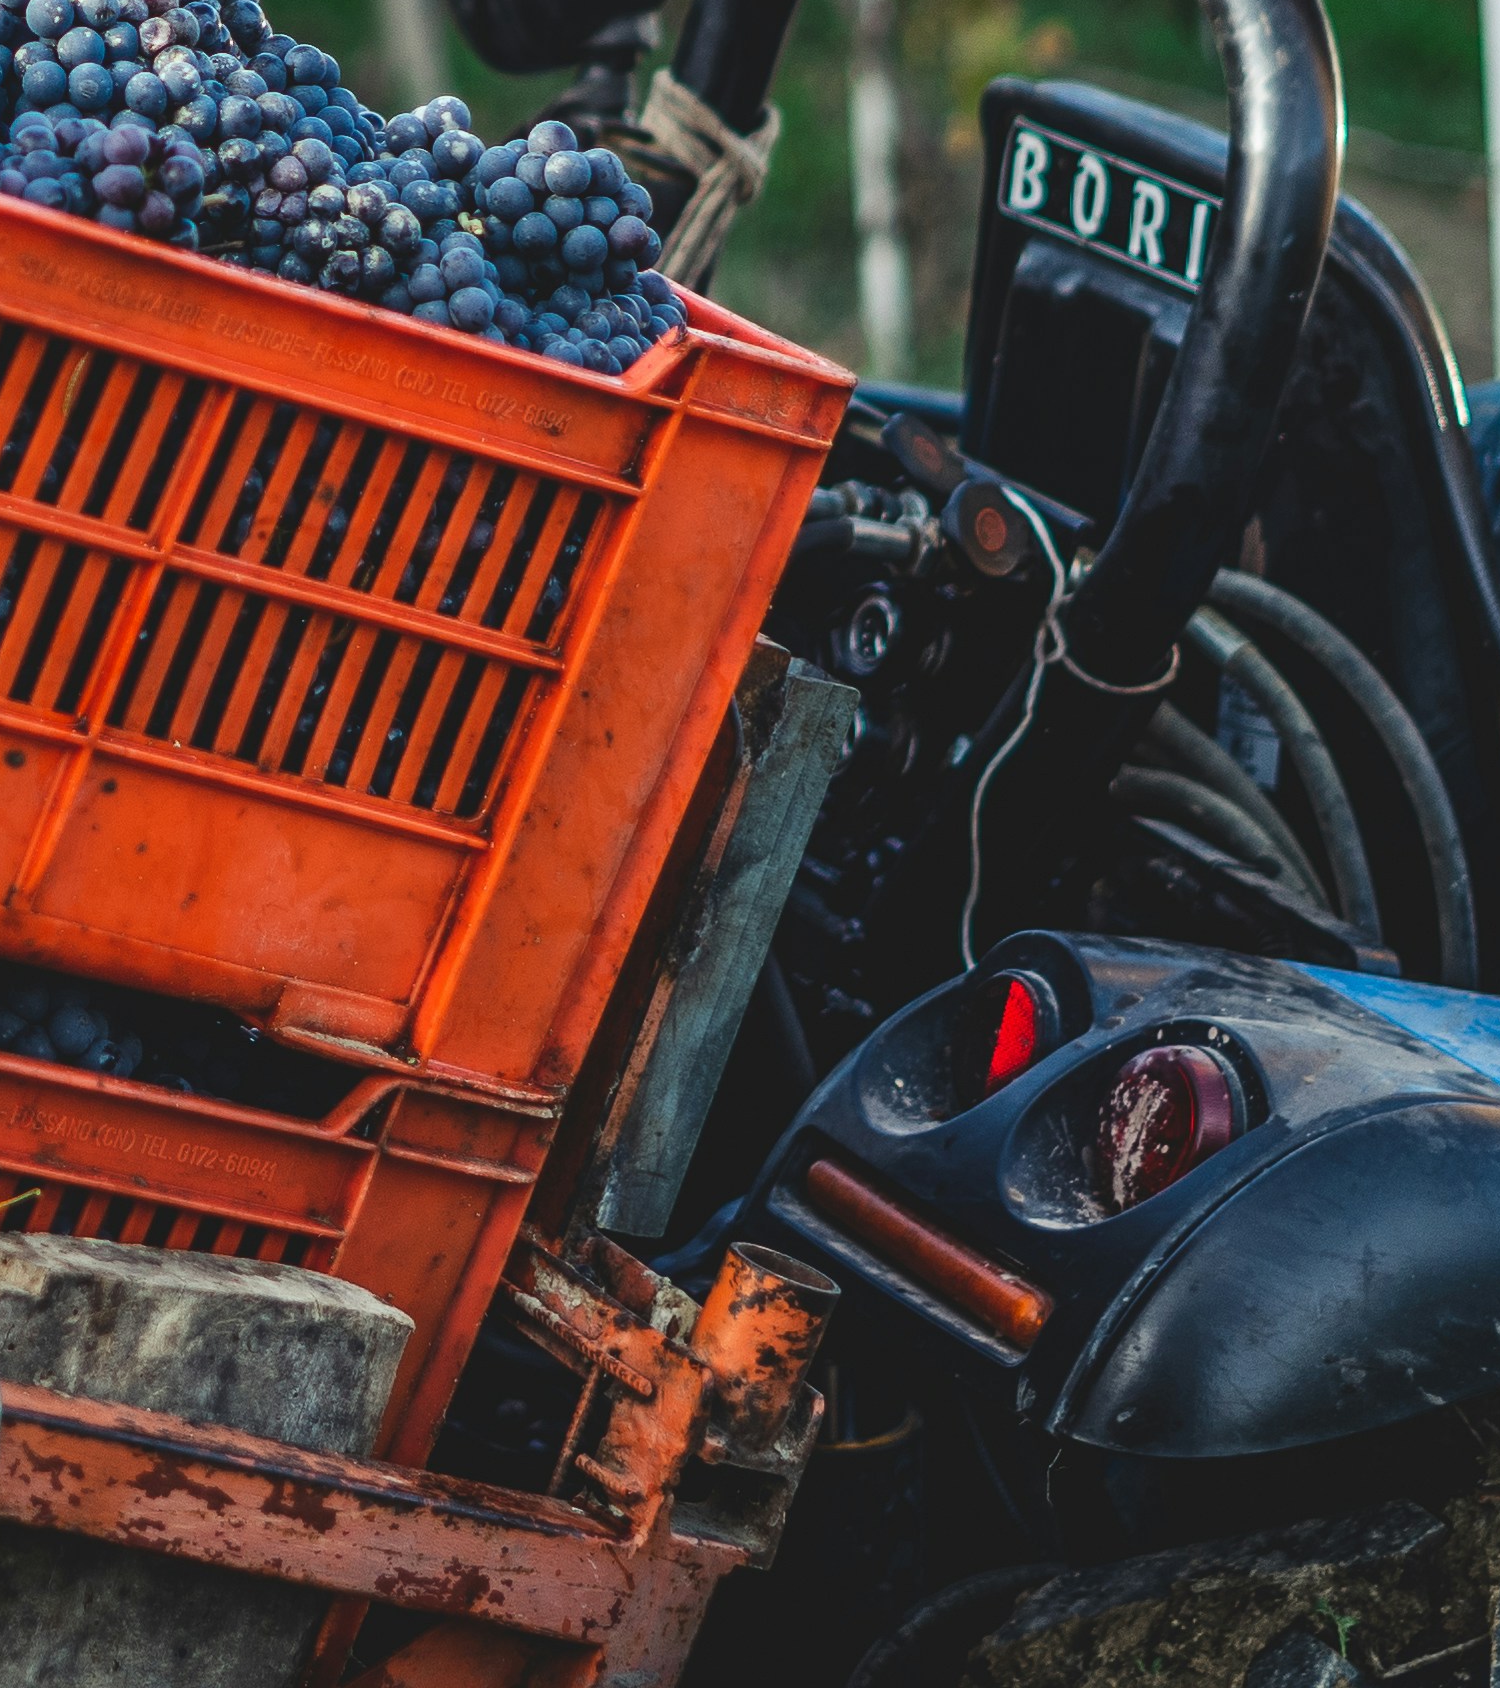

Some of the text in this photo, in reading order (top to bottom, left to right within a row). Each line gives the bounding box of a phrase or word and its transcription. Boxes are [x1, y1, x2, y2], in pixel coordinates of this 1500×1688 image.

[136, 289, 212, 330] MATERIE
[394, 365, 436, 395] (CN)
[441, 378, 472, 407] TEL.
[476, 390, 574, 433] 0172-60941
[95, 1123, 137, 1153] (CN)
[140, 1133, 173, 1160] TEL.
[177, 1142, 278, 1182] 0172-60941
